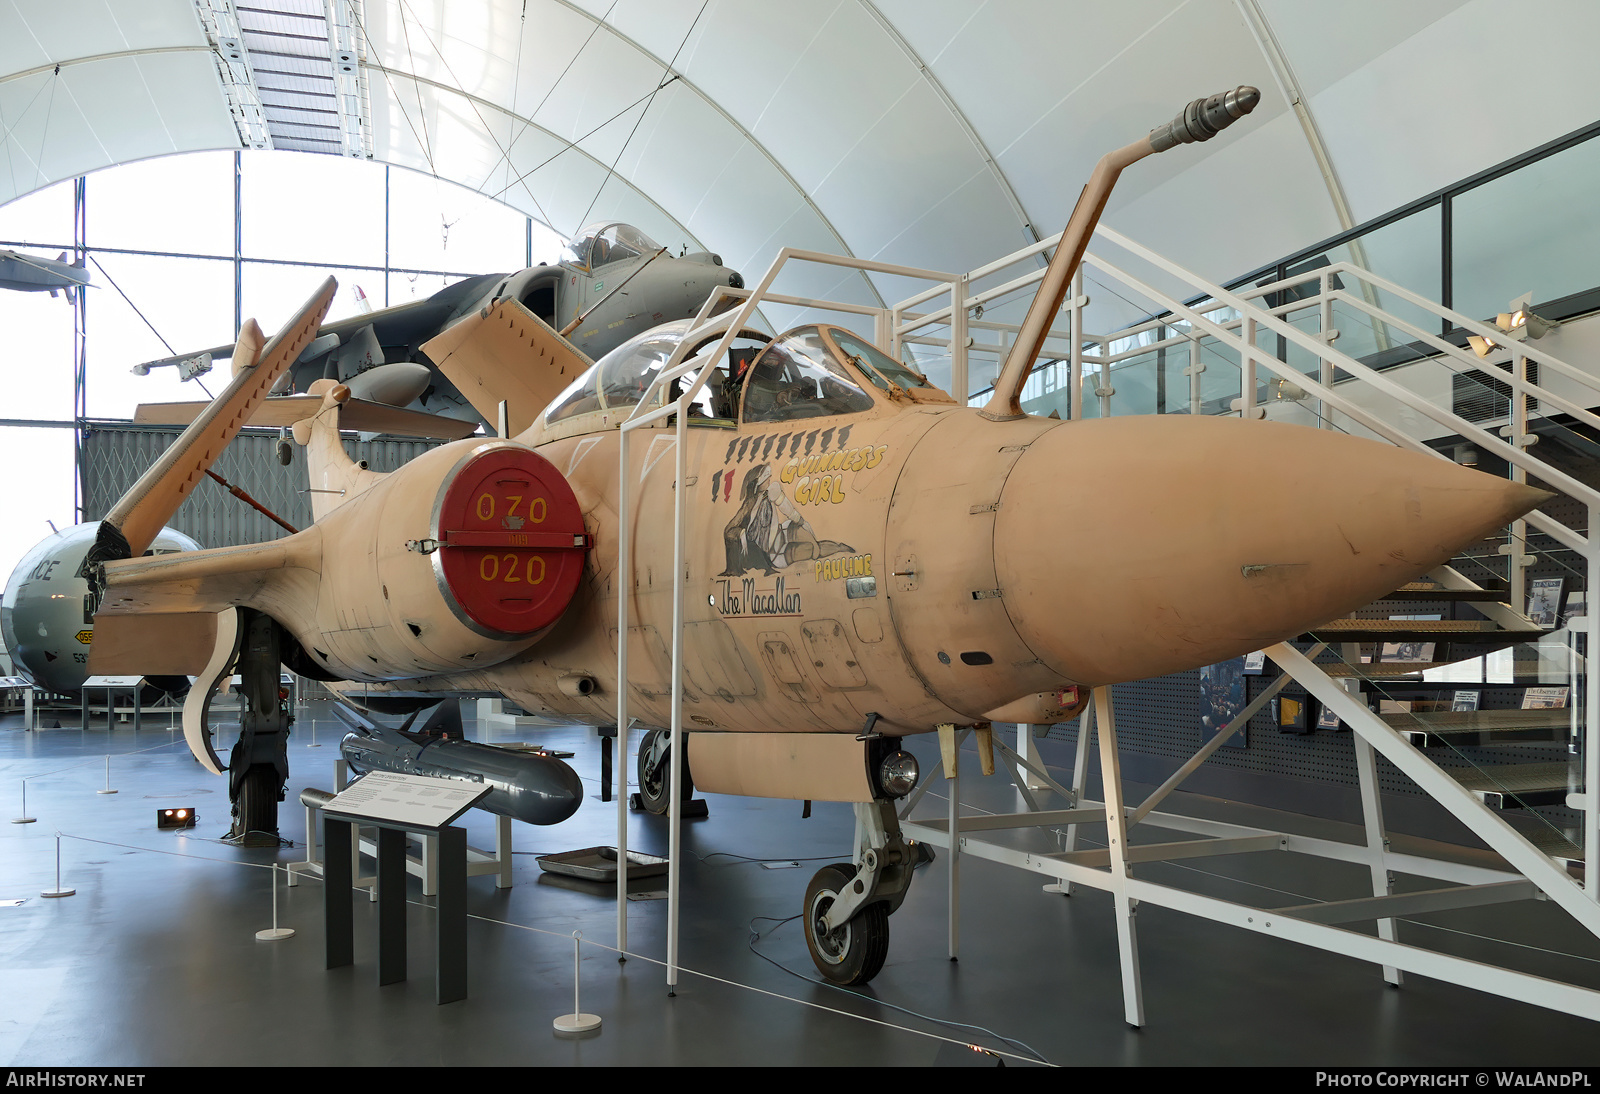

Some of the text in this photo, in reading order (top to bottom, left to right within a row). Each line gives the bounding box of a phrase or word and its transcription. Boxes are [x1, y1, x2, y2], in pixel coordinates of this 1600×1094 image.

[780, 445, 888, 483] GUINNESS
[794, 474, 845, 506] GIRL
[480, 554, 546, 585] 020
[815, 553, 873, 583] PAULINE
[742, 576, 801, 614] Macallan
